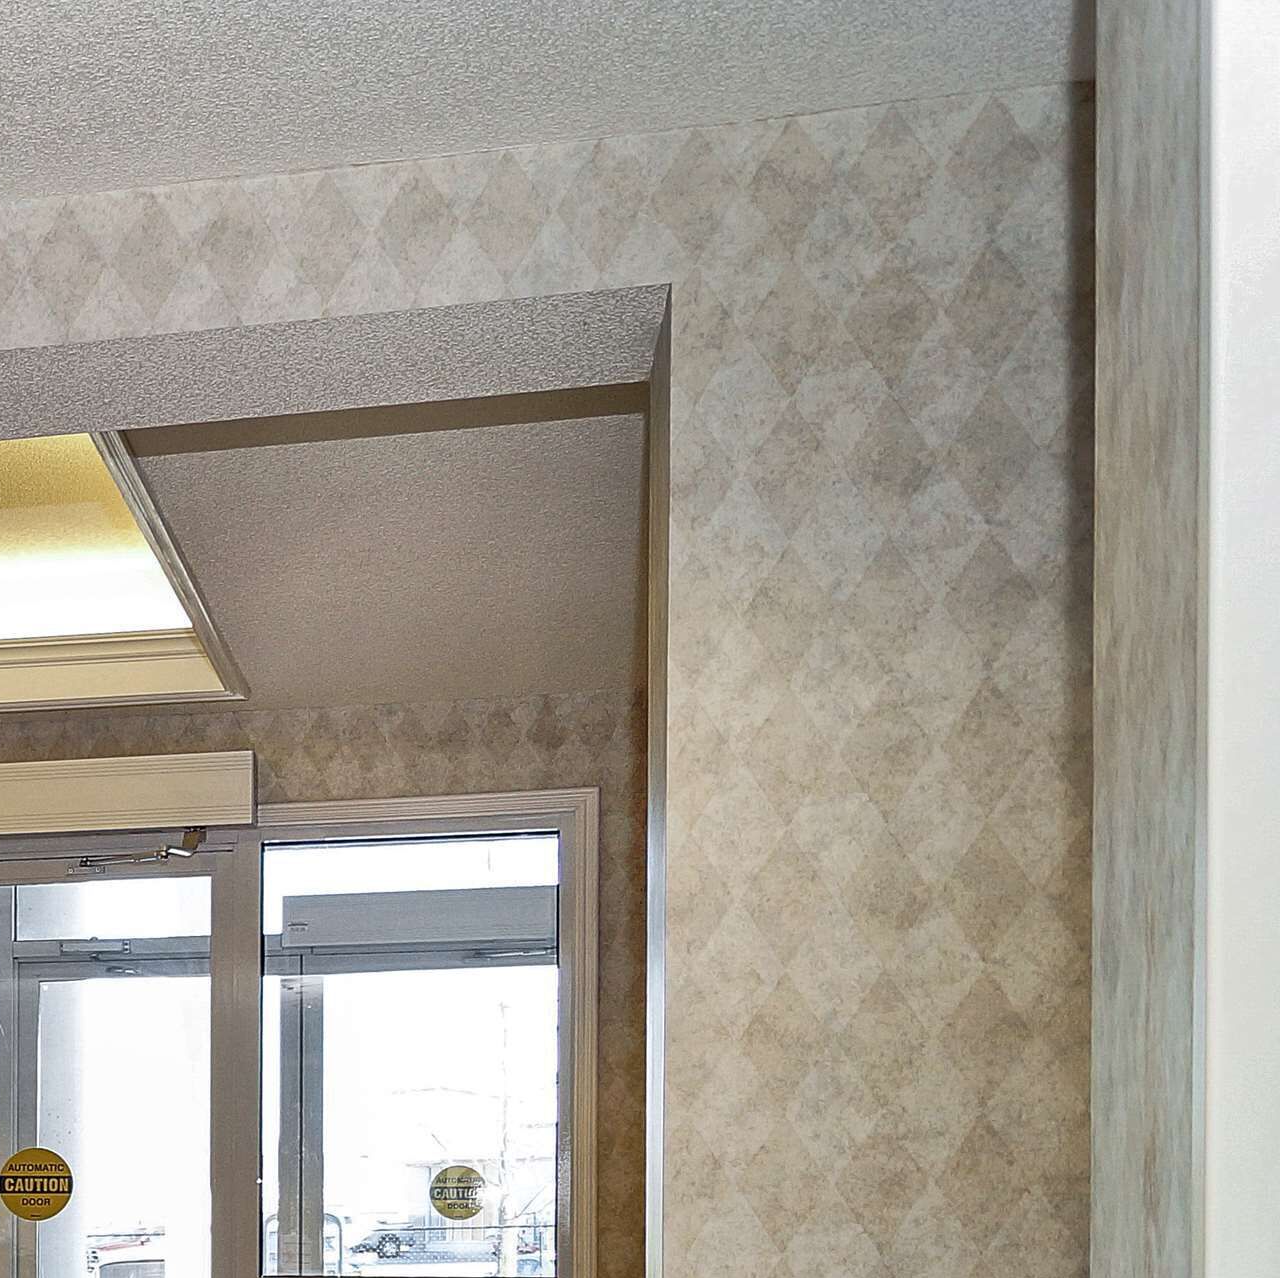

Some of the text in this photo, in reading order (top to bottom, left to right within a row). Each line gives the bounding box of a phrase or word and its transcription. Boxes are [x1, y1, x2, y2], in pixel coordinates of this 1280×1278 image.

[7, 1163, 65, 1172] AUTOMATIC
[4, 1178, 69, 1192] CAUTION
[21, 1197, 51, 1206] DOOR
